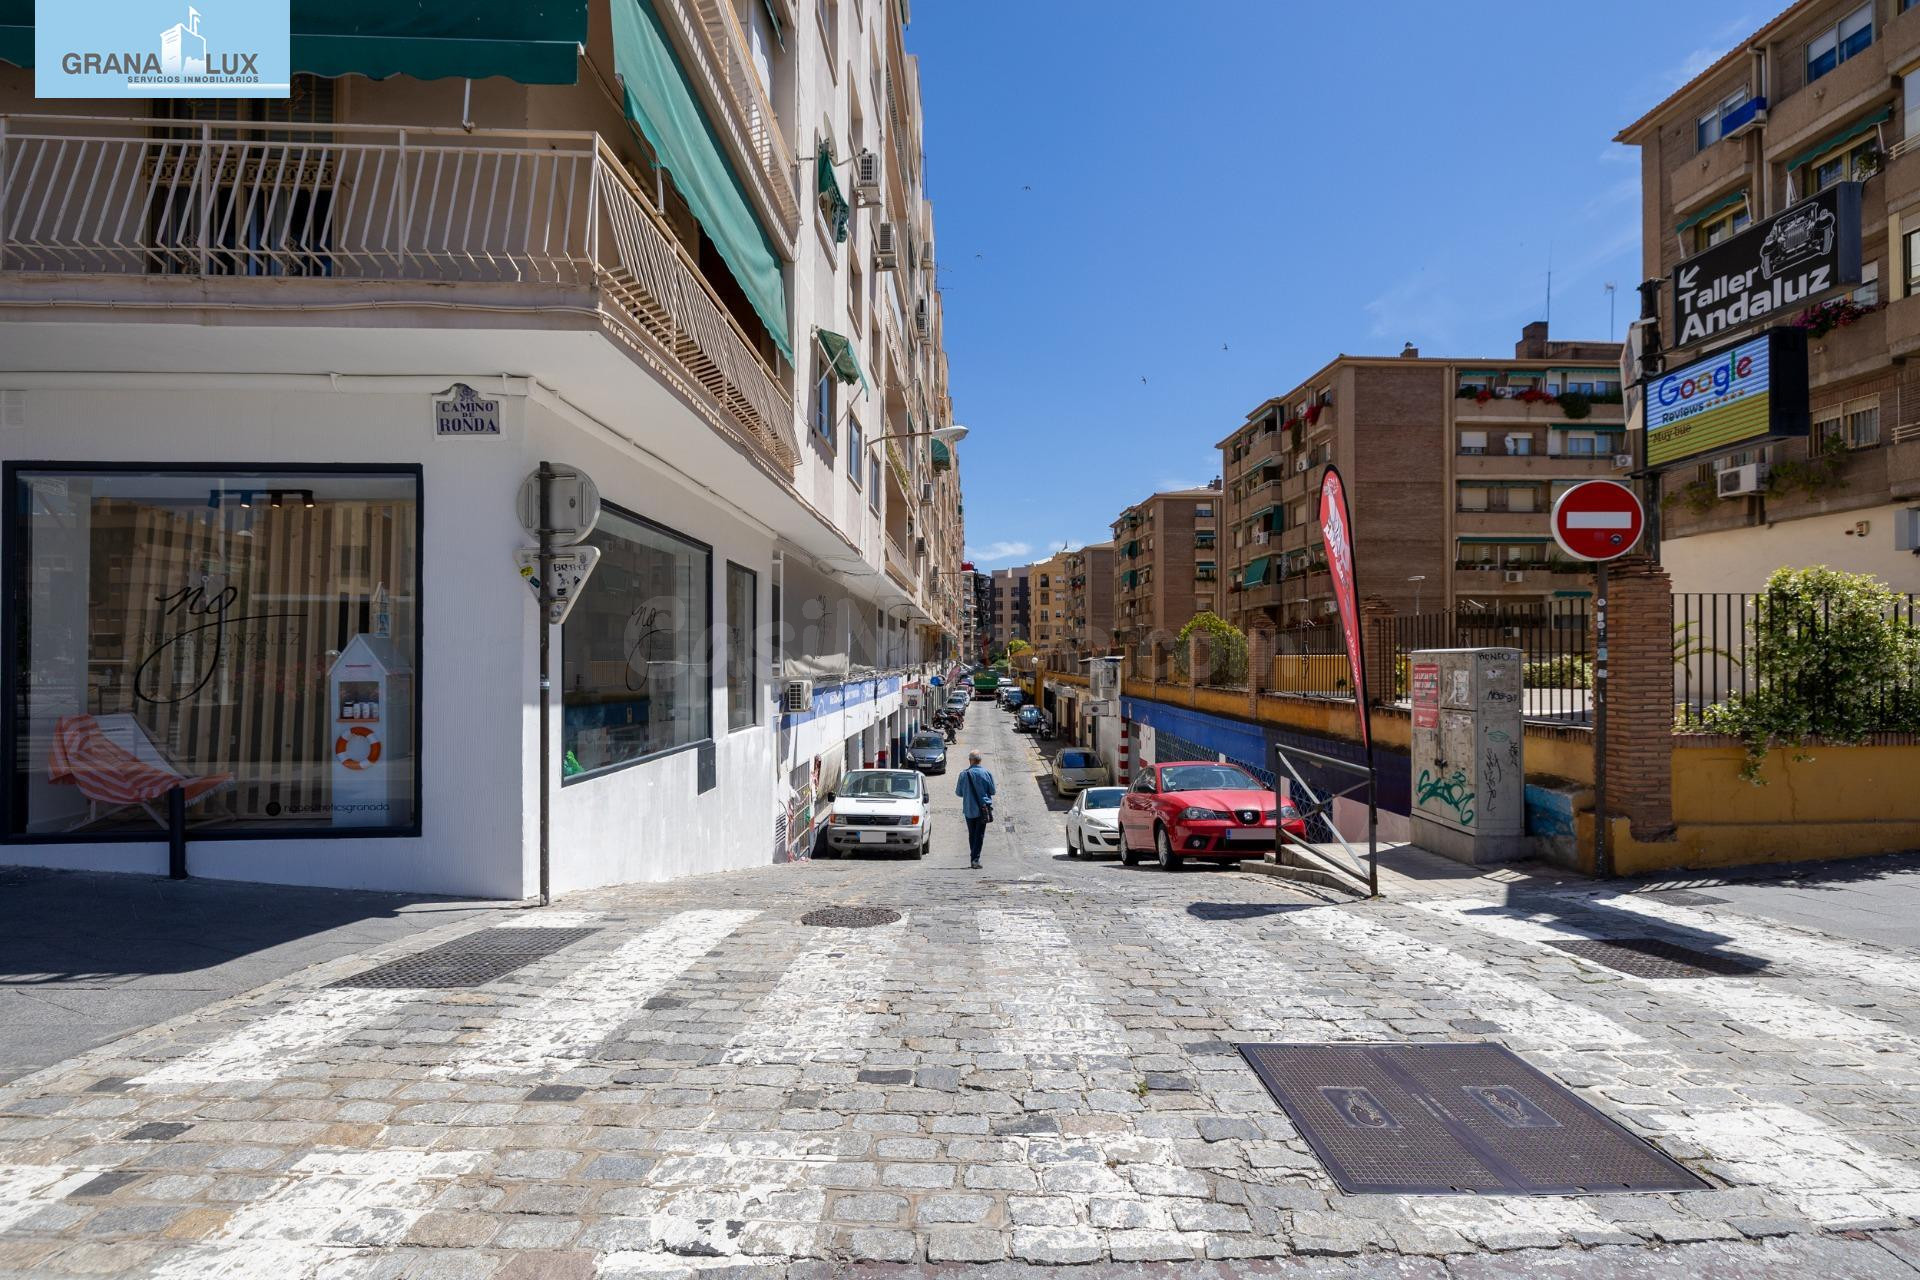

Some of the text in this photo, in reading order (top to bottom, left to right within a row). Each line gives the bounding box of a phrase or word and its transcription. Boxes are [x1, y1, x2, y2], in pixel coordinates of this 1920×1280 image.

[1679, 266, 1759, 314] Taller
[1679, 264, 1830, 345] Andaluz
[1658, 351, 1753, 406] Google
[440, 418, 496, 432] RONDA
[441, 402, 494, 412] CAMINO
[1662, 400, 1705, 424] Reviews
